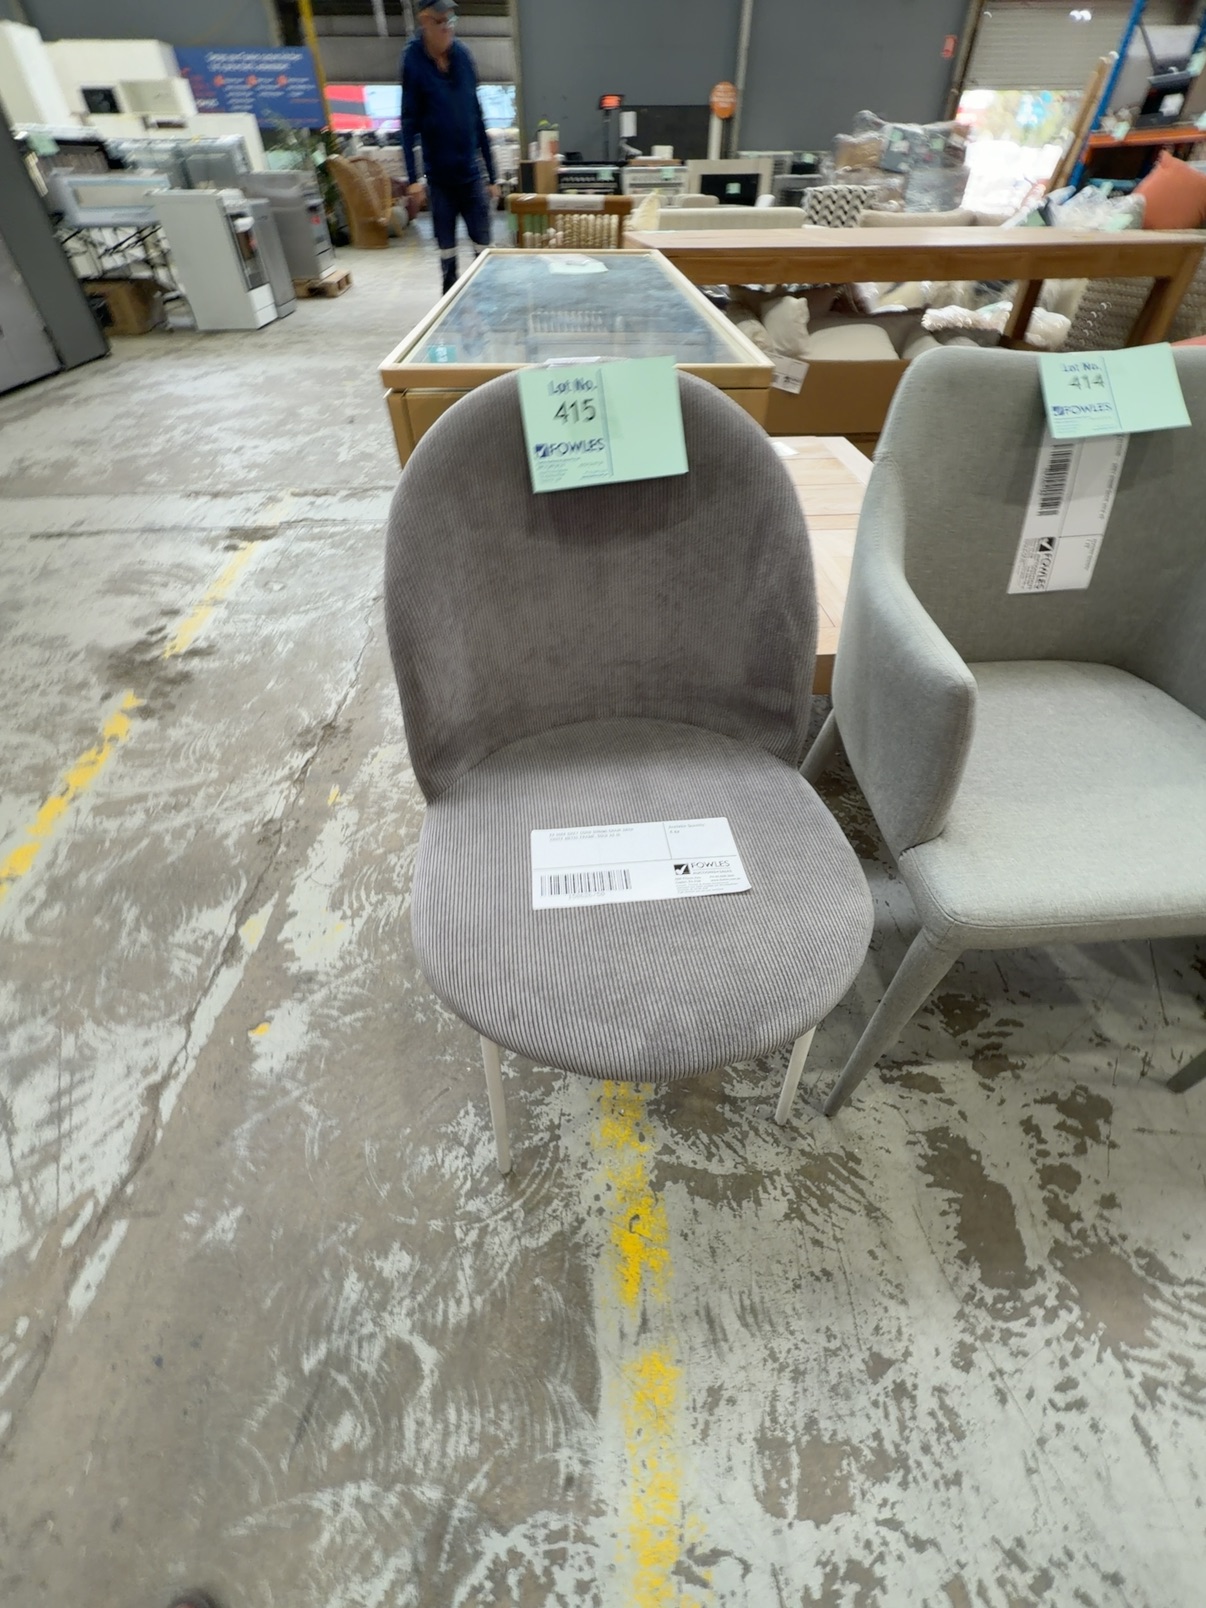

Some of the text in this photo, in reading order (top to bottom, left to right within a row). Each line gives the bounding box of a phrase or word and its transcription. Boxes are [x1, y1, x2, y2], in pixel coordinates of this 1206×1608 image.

[548, 378, 598, 395] Lot No.
[1068, 374, 1105, 390] 414
[553, 398, 597, 425] 415
[1064, 403, 1112, 416] FOWLES
[549, 438, 606, 457] FOWLES
[690, 860, 731, 869] FOWLES
